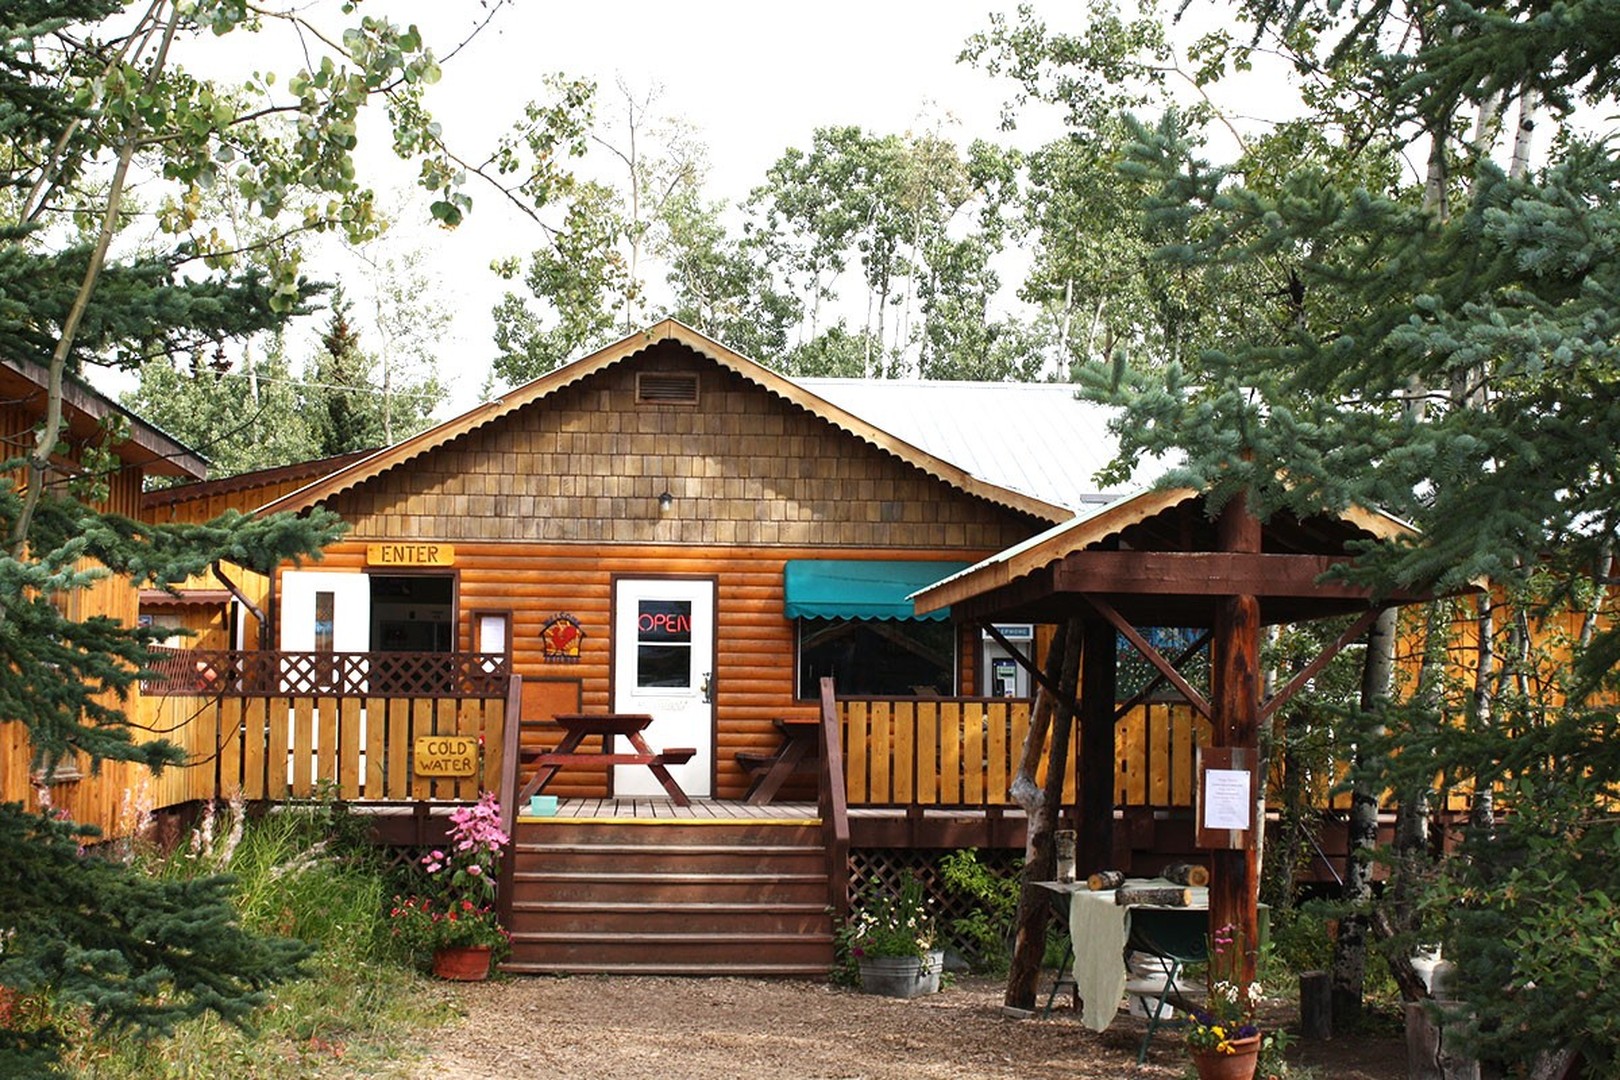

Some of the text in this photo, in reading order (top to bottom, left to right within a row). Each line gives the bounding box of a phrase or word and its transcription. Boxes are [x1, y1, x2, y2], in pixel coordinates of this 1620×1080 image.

[381, 545, 439, 563] ENTER
[638, 613, 692, 633] OPEN
[427, 741, 467, 756] COLD
[419, 757, 472, 772] WATER
